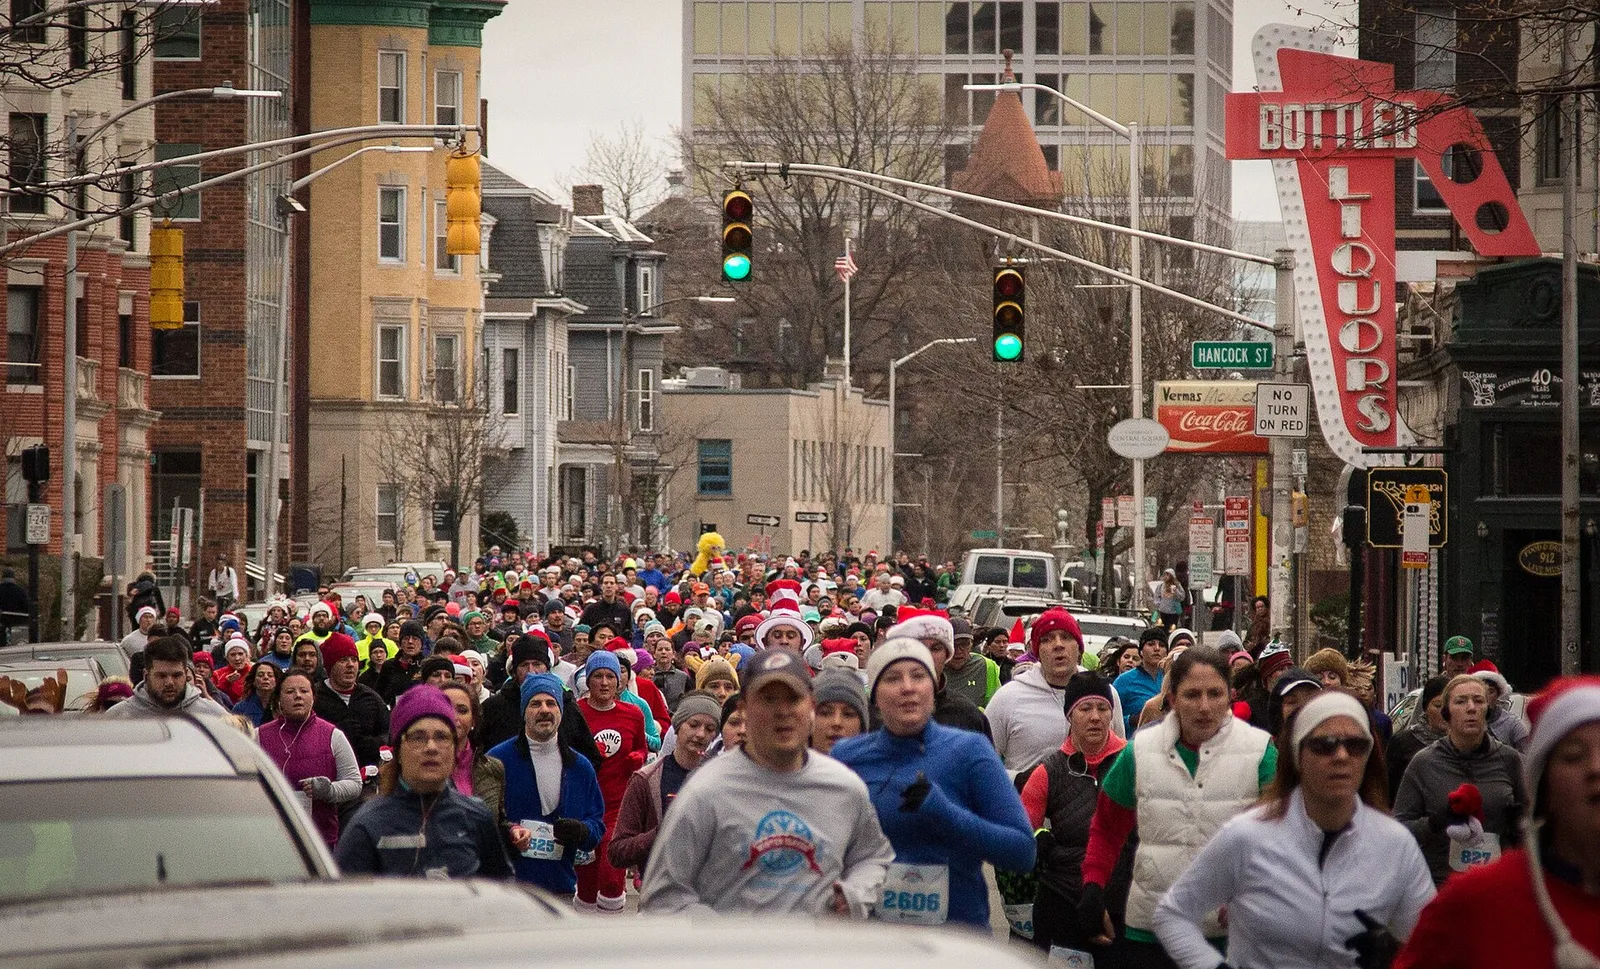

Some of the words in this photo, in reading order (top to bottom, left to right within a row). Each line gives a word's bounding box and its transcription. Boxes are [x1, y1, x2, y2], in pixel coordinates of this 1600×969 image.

[1259, 101, 1418, 150] BOTTLED
[1328, 165, 1391, 434] LIQUORS
[1199, 347, 1249, 363] HANCOCK
[1255, 347, 1268, 363] ST
[1531, 368, 1551, 386] 40
[1163, 387, 1202, 402] Vermas
[1273, 390, 1293, 401] NO
[1267, 405, 1298, 416] TURN
[1260, 420, 1275, 430] ON
[1281, 420, 1304, 431] RED
[1540, 552, 1555, 563] 912
[595, 732, 621, 744] THING
[605, 744, 612, 754] 2
[529, 838, 555, 853] 525
[1461, 849, 1492, 865] 827
[883, 890, 940, 912] 2606
